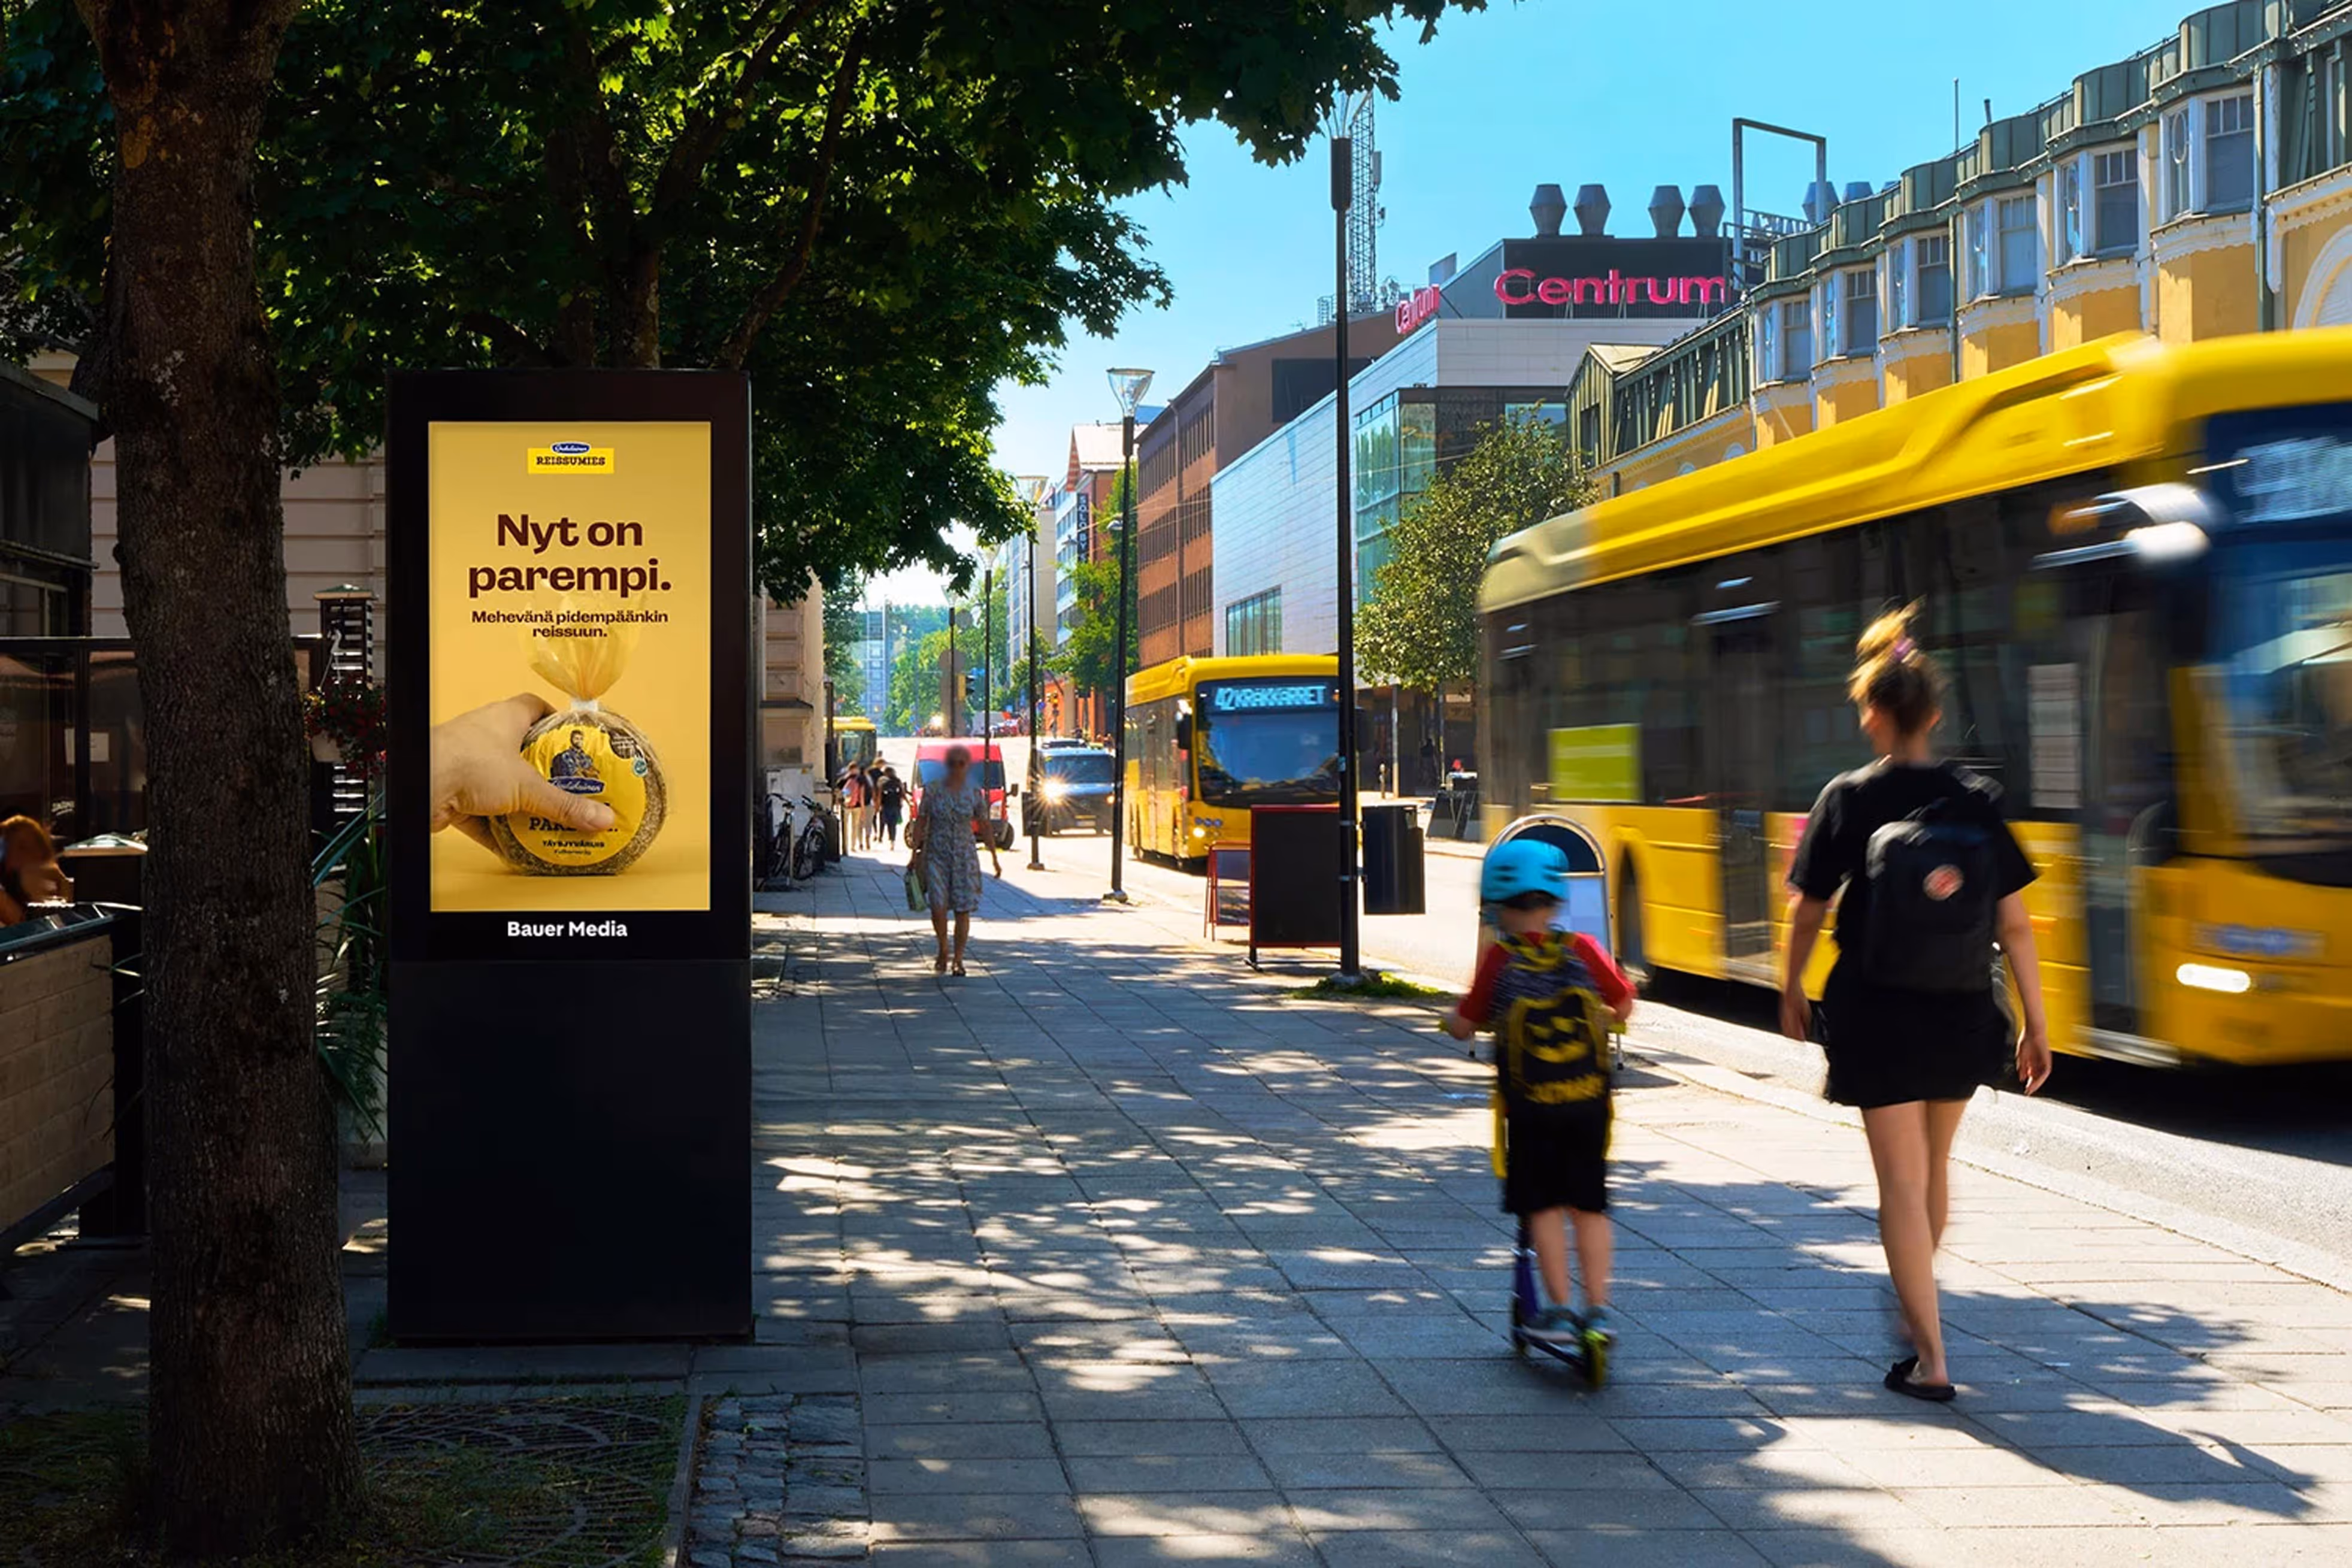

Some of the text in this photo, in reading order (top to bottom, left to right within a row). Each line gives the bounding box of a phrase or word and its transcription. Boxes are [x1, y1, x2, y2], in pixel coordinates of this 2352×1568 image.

[1494, 268, 1725, 305] Centrum
[537, 456, 606, 465] REISSUMIES
[498, 514, 643, 554] Nyt on
[469, 558, 671, 598] parempi.
[471, 611, 668, 625] Mehevänä pidempäänkin
[532, 626, 607, 637] reissuun.
[508, 921, 628, 936] Bauer Media
